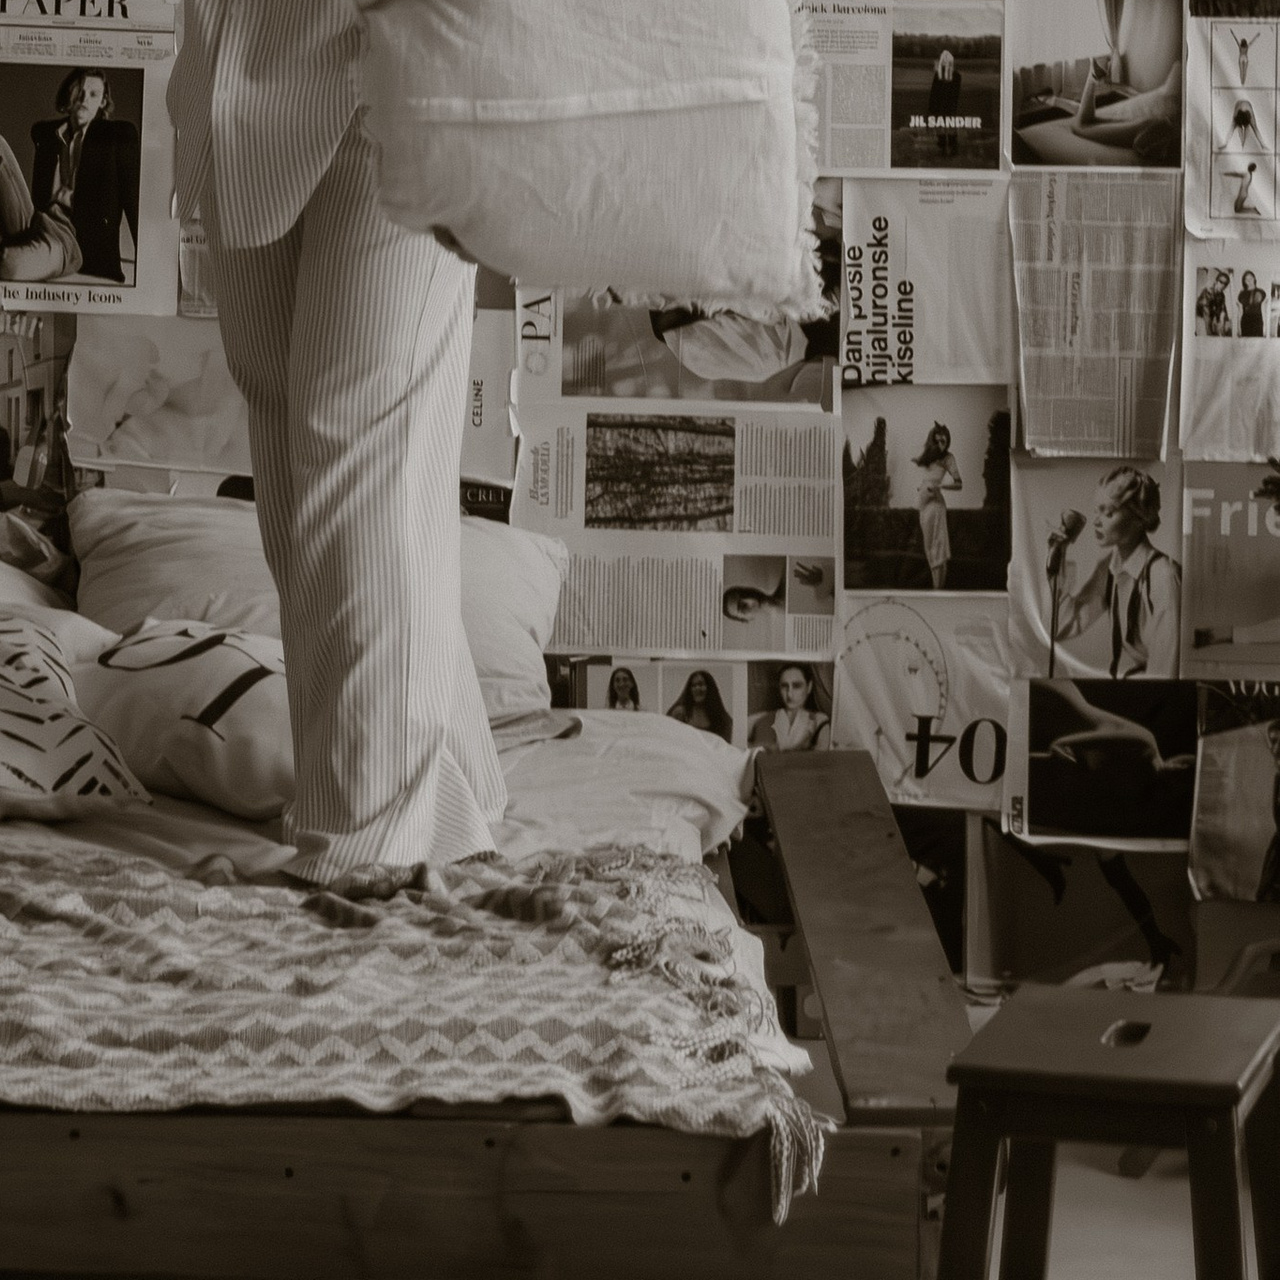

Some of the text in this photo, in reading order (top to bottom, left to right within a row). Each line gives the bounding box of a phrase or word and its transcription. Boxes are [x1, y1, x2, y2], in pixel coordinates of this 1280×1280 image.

[909, 114, 982, 128] JIL SANDER
[25, 287, 83, 306] Industry
[87, 289, 123, 304] Icons
[866, 215, 893, 385] hijaluronske
[841, 329, 864, 385] Dan
[891, 278, 915, 384] kiseline
[471, 378, 484, 429] CELINE
